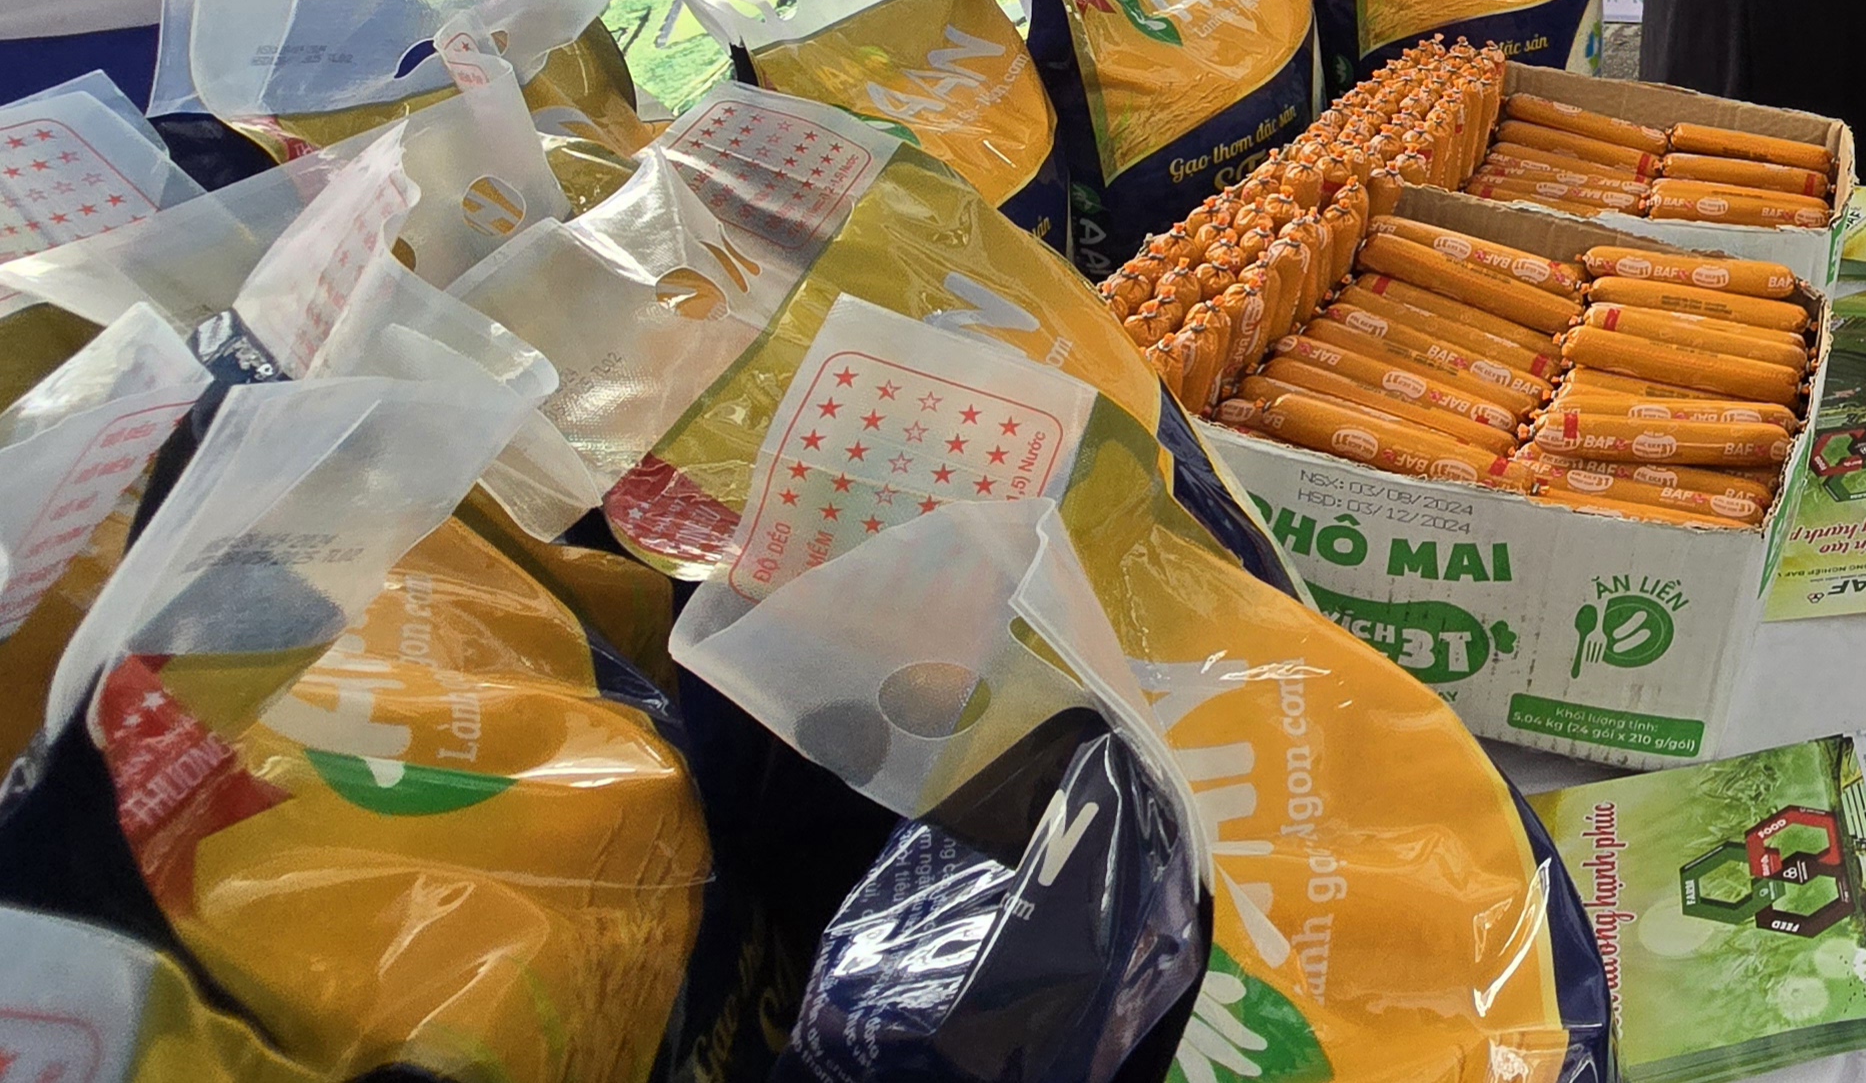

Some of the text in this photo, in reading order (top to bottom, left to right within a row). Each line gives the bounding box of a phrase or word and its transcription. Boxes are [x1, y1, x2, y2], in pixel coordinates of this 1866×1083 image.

[1523, 34, 1549, 54] sản
[1170, 154, 1208, 184] Gạo
[1213, 133, 1254, 165] thơm
[1256, 117, 1278, 144] đặc
[1663, 196, 1686, 208] BAF
[1483, 253, 1513, 269] BAF
[1654, 266, 1680, 279] BAF
[1309, 349, 1472, 413] BAF BAF
[1427, 345, 1542, 397] BAF BAF
[1024, 430, 1047, 474] Nước
[1583, 434, 1755, 457] BAF BAF
[1395, 455, 1429, 473] BAF
[1300, 469, 1345, 491] NSX:
[1297, 488, 1343, 509] HSD:
[1661, 487, 1694, 501] BAF
[1804, 521, 1859, 544] hạnh
[753, 520, 793, 585] ĐỘ DẺO
[1818, 540, 1851, 554] tạo
[1386, 537, 1513, 583] MAI
[1591, 574, 1690, 612] ĂN LIỀN
[1397, 628, 1473, 673] 3T
[1566, 720, 1589, 735] (24
[1629, 733, 1651, 746] 210
[1757, 818, 1787, 839] FOOD
[1582, 801, 1628, 908] hạnh phúc
[1771, 919, 1800, 933] FEED
